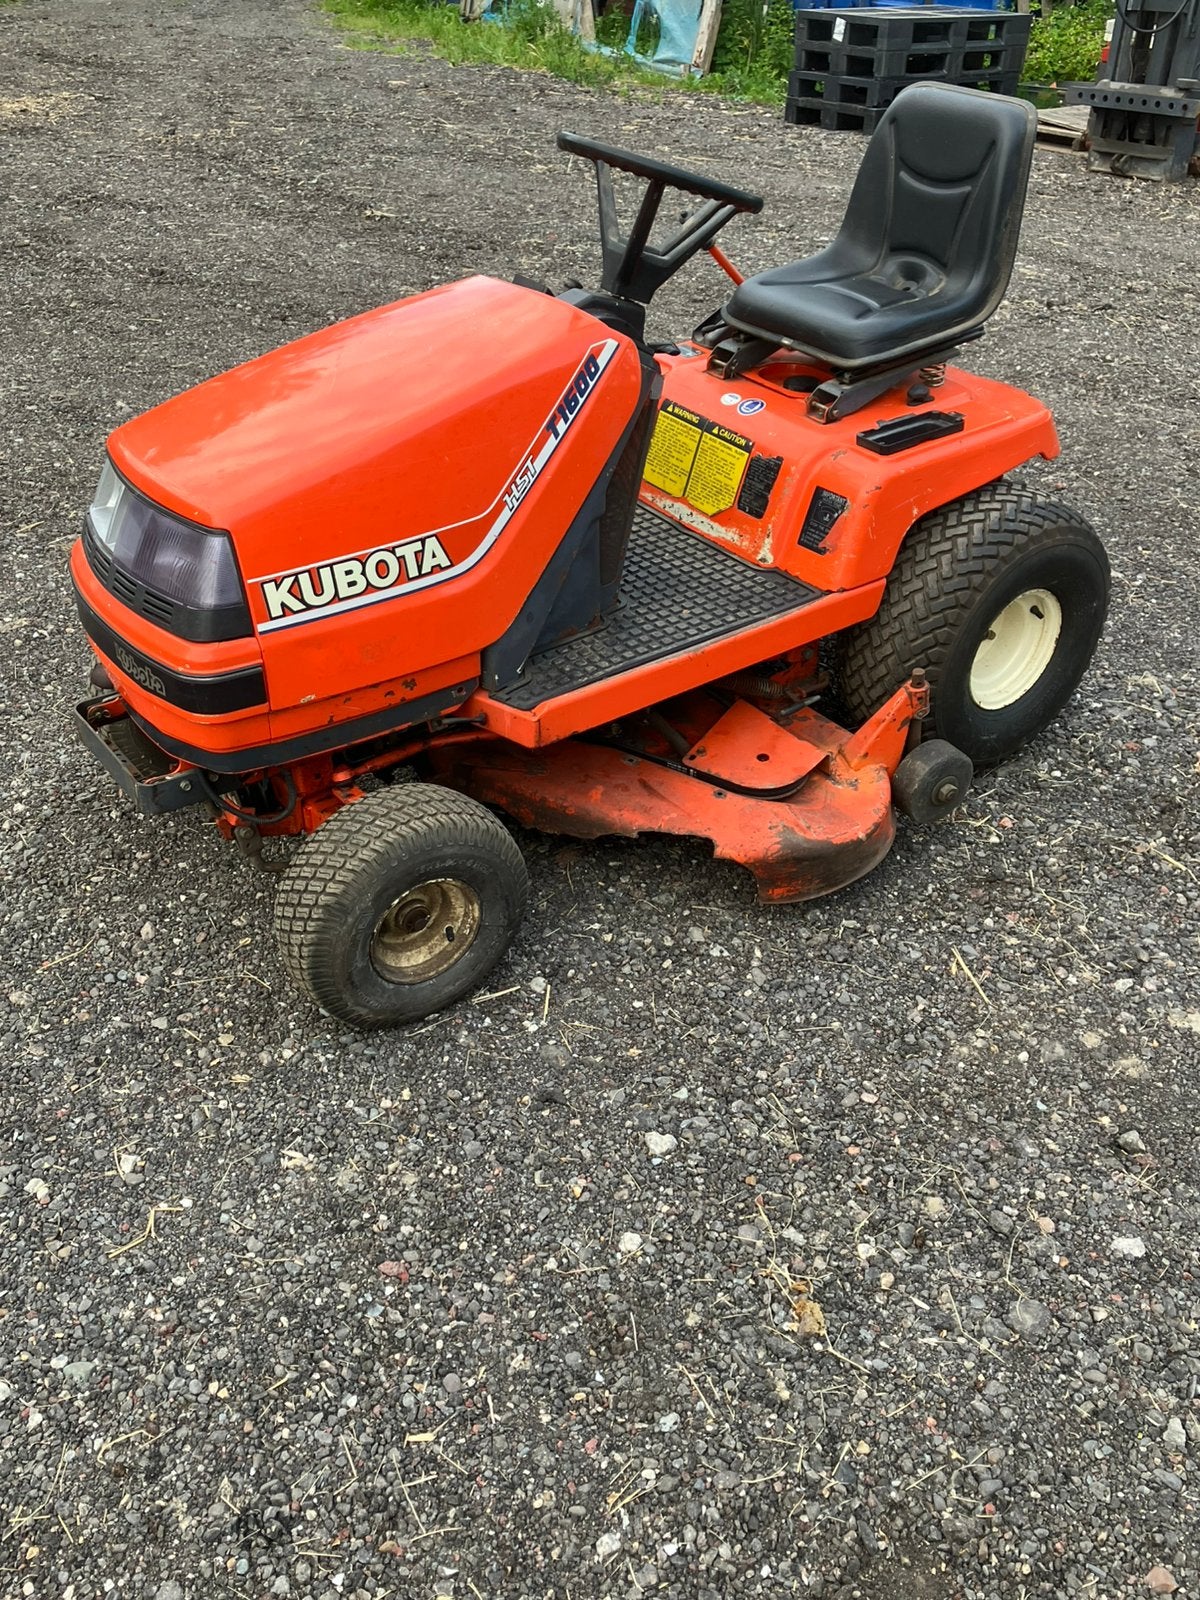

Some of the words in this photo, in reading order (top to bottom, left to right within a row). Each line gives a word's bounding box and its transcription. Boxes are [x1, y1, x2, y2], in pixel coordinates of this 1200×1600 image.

[545, 353, 600, 441] T1600
[673, 407, 700, 424] WARNING
[719, 428, 746, 446] CAUTION
[502, 455, 538, 514] HST
[261, 535, 452, 619] KUBOTA
[113, 641, 166, 697] Kubota
